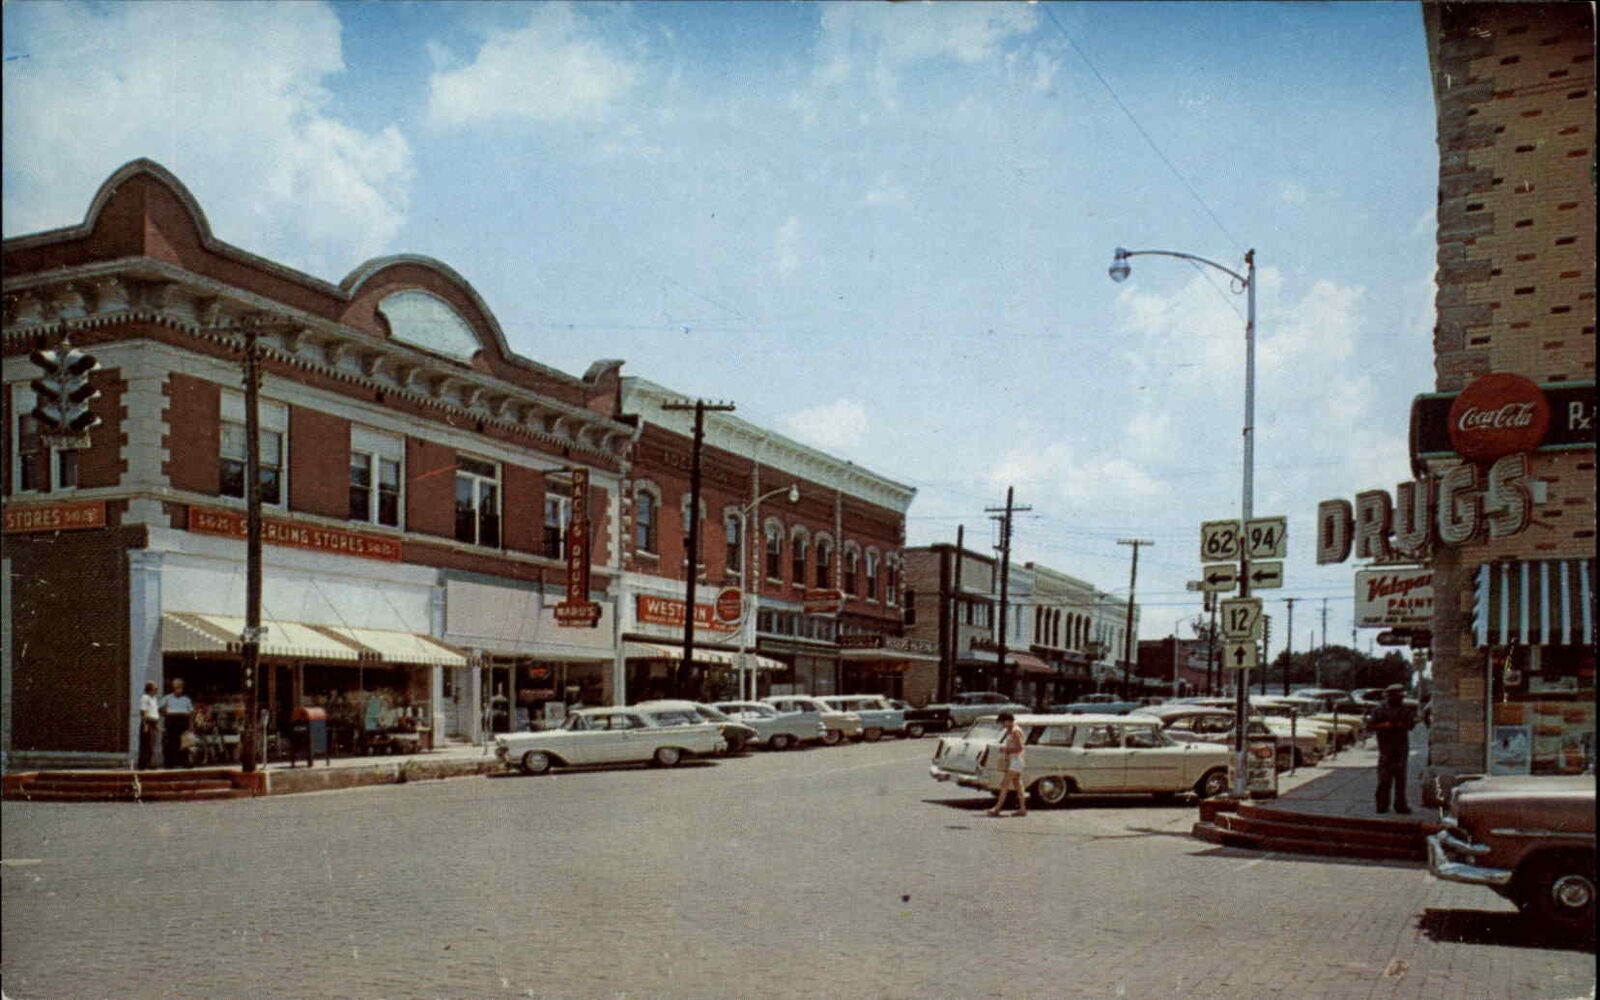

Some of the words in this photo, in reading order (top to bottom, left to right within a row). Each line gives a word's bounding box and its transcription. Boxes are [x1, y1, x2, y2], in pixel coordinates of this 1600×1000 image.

[6, 509, 60, 528] STORES
[1316, 453, 1532, 566] DRUGS
[240, 518, 309, 545] SERLING
[314, 531, 364, 553] STORES
[1207, 530, 1234, 553] 62
[1251, 527, 1274, 550] 94
[1231, 608, 1249, 631] 12
